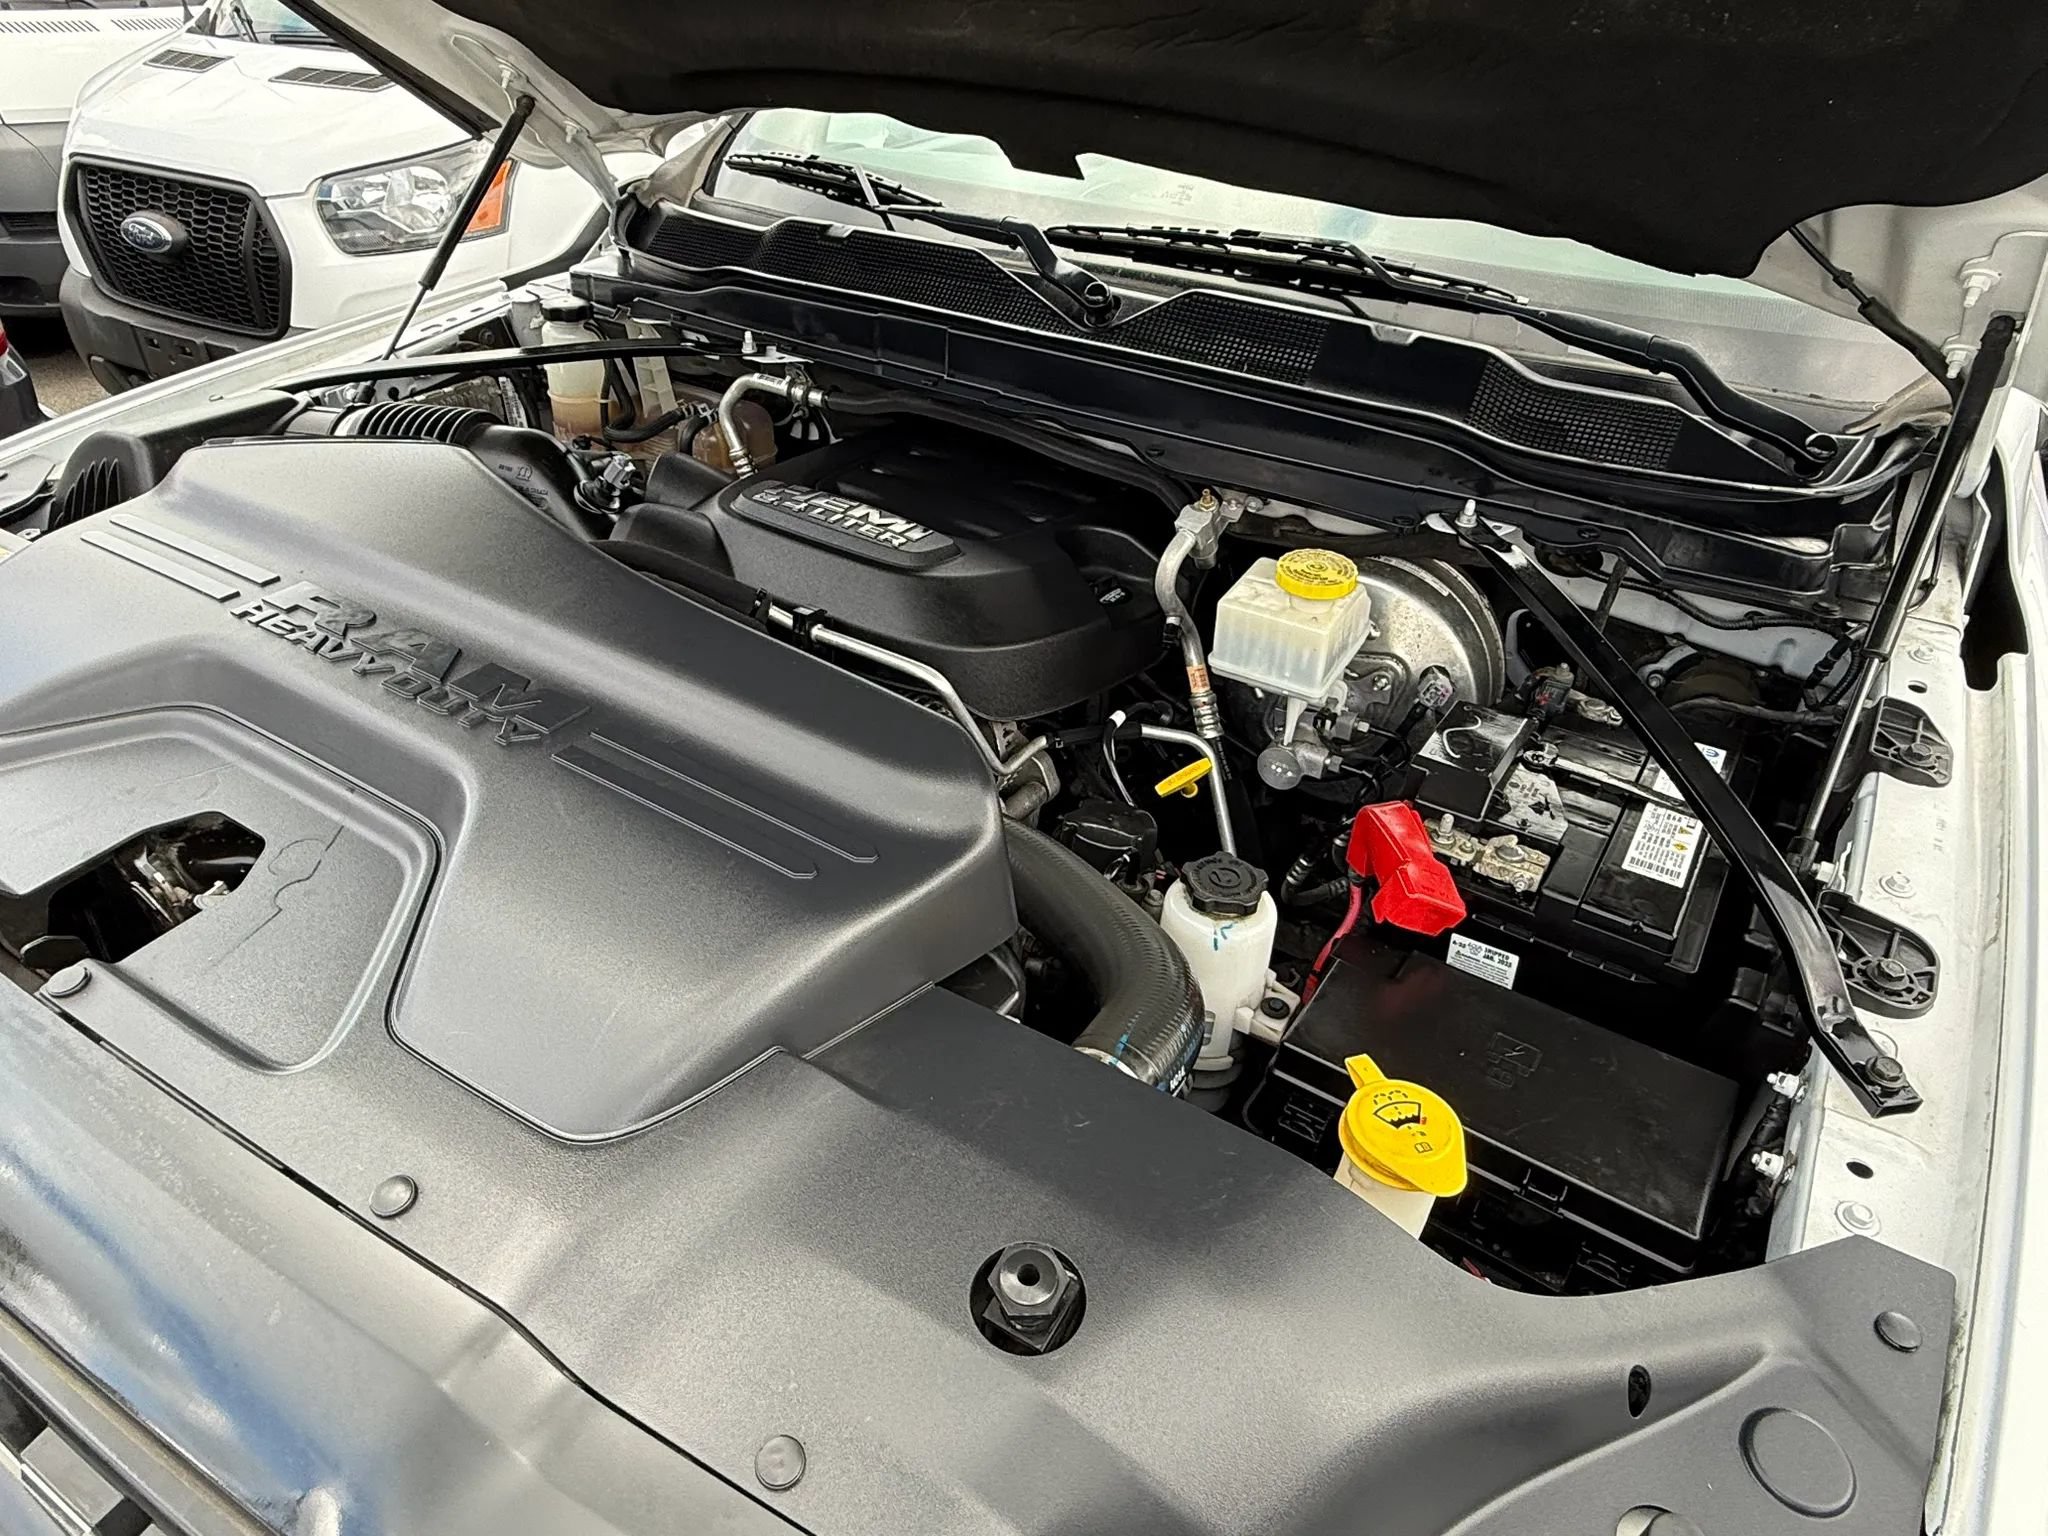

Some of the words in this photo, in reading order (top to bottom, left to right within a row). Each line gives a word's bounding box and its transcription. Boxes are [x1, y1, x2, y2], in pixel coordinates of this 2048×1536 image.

[127, 222, 157, 247] Ford
[763, 484, 934, 542] HEMI
[808, 507, 908, 549] LITER
[230, 601, 396, 676] HEAVY
[380, 669, 542, 746] DUTY
[261, 580, 592, 734] RAM
